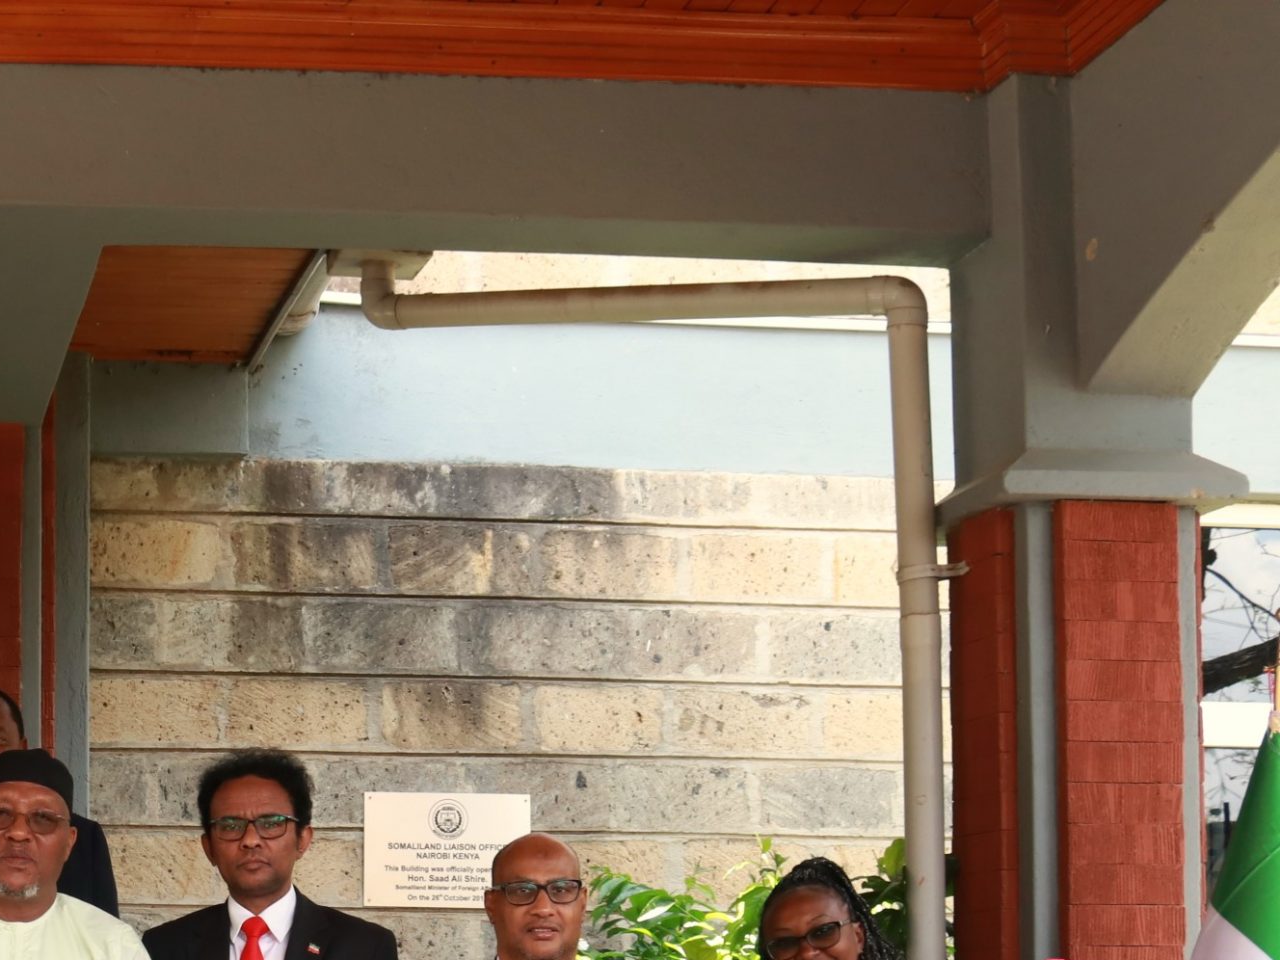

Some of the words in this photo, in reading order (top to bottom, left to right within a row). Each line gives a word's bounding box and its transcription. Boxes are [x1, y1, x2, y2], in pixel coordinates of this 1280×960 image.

[388, 842, 441, 850] SOMALILAND
[444, 843, 476, 851] LIAISON
[416, 852, 450, 860] NAIROBI
[401, 865, 429, 873] Building
[446, 866, 475, 874] officially
[408, 874, 427, 882] Hon.
[429, 874, 450, 882] Saad
[464, 875, 488, 883] Shire.
